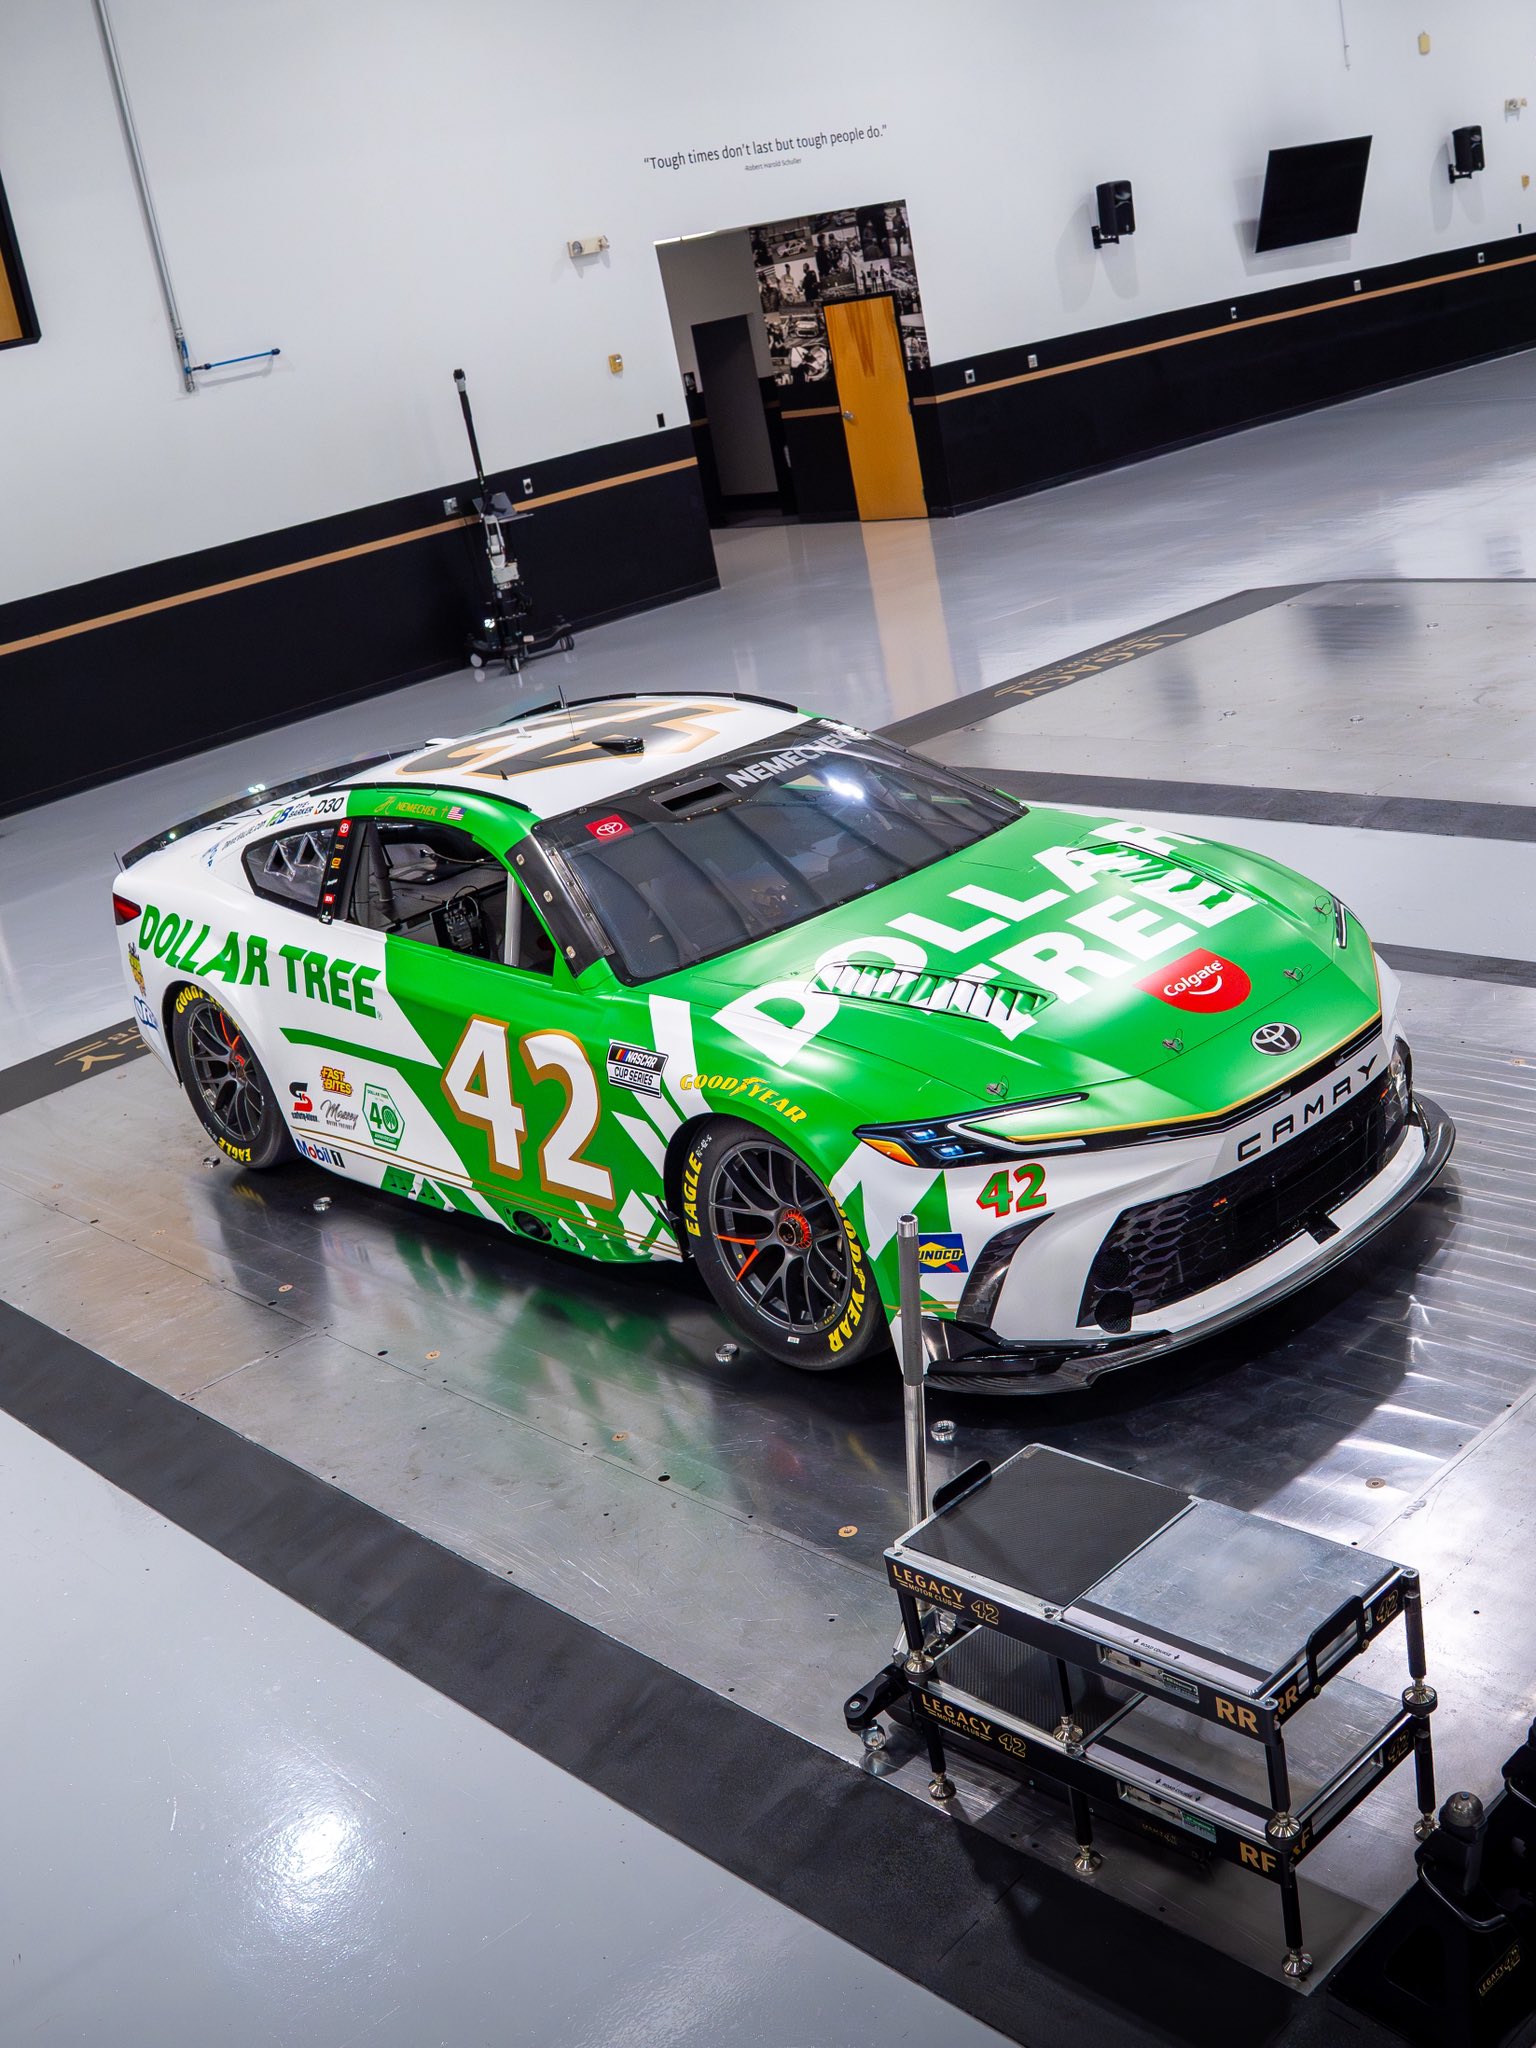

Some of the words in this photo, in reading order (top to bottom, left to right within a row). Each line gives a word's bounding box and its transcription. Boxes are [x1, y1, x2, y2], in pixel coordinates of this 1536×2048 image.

[688, 149, 720, 164] times
[722, 144, 751, 160] don’t
[752, 141, 774, 155] last
[775, 138, 795, 152] but
[796, 132, 828, 150] tough
[829, 127, 865, 147] people
[1012, 633, 1188, 697] LEGACY
[725, 731, 853, 788] NEMECHEK
[396, 802, 438, 817] NEMECHEK
[710, 820, 1214, 1068] DOLLAR
[922, 866, 1259, 1042] TREE
[138, 904, 270, 988] DOLLAR
[279, 944, 382, 1019] TREE
[1163, 962, 1223, 996] Colgate
[321, 1066, 345, 1081] FAST
[614, 1066, 629, 1080] CUP
[628, 1069, 654, 1086] SERIES
[625, 1050, 658, 1069] NASCAR
[324, 1080, 352, 1096] BITES
[680, 1073, 808, 1125] GOODYEAR
[440, 1013, 617, 1212] 42
[1236, 1054, 1378, 1163] CAMRY
[217, 1136, 252, 1162] EAGLE
[295, 1138, 333, 1165] Mobil
[683, 1151, 703, 1237] EAGLE
[976, 1163, 1048, 1218] 42
[919, 1249, 961, 1261] UNOCO
[892, 1563, 964, 1604] LEGACY
[908, 1583, 935, 1599] MOTOR
[934, 1593, 954, 1607] CLUB
[970, 1599, 1000, 1625] 42
[1376, 1589, 1399, 1624] 42
[921, 1693, 992, 1735] LEGACY
[936, 1713, 962, 1728] MOTOR
[962, 1723, 981, 1738] CLUB
[1214, 1696, 1260, 1735] RR
[997, 1732, 1027, 1759] 42
[1239, 1841, 1277, 1873] RF
[1478, 1964, 1504, 1995] LEGACY
